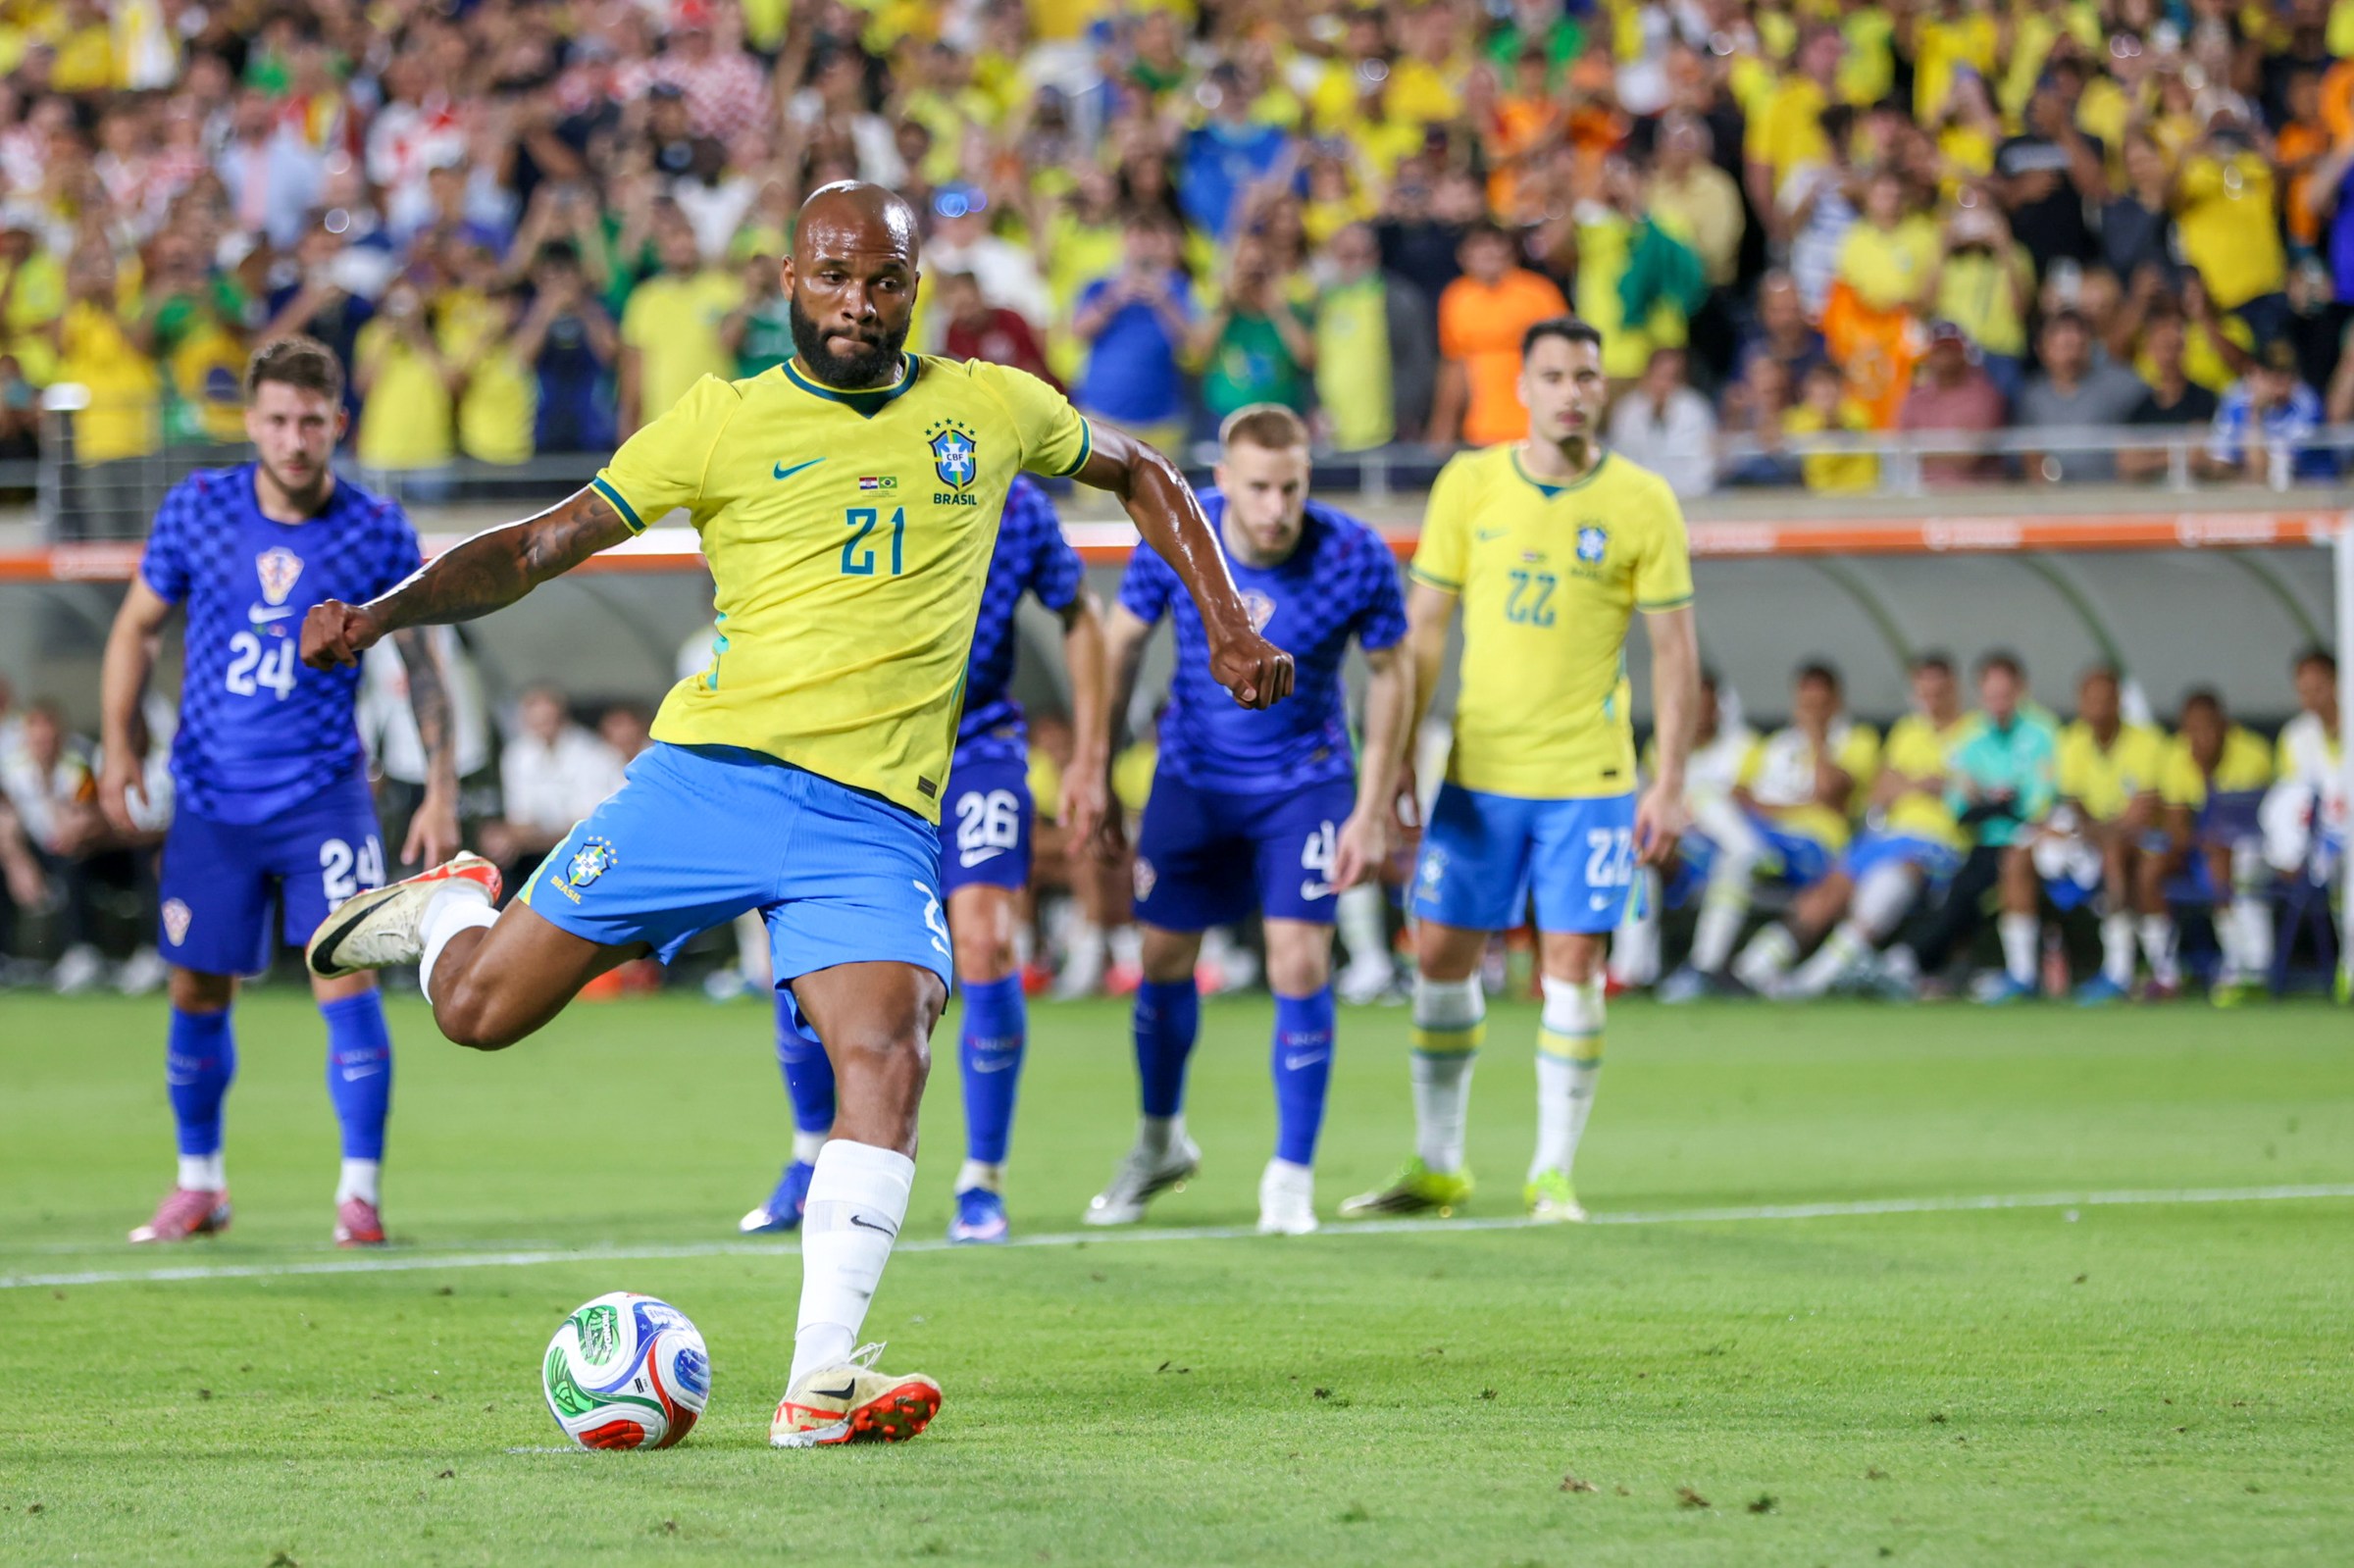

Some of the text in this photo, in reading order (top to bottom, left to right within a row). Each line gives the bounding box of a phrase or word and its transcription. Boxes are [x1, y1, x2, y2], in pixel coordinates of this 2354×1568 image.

[947, 453, 963, 462] CBF
[933, 493, 977, 505] BRASIL
[841, 506, 905, 576] 21
[1506, 570, 1557, 628] 22
[225, 631, 297, 702] 24
[955, 788, 1019, 852] 26
[319, 834, 386, 900] 24
[1586, 827, 1634, 888] 22
[550, 875, 582, 905] BRASIL
[601, 1309, 613, 1352] TRIONDA
